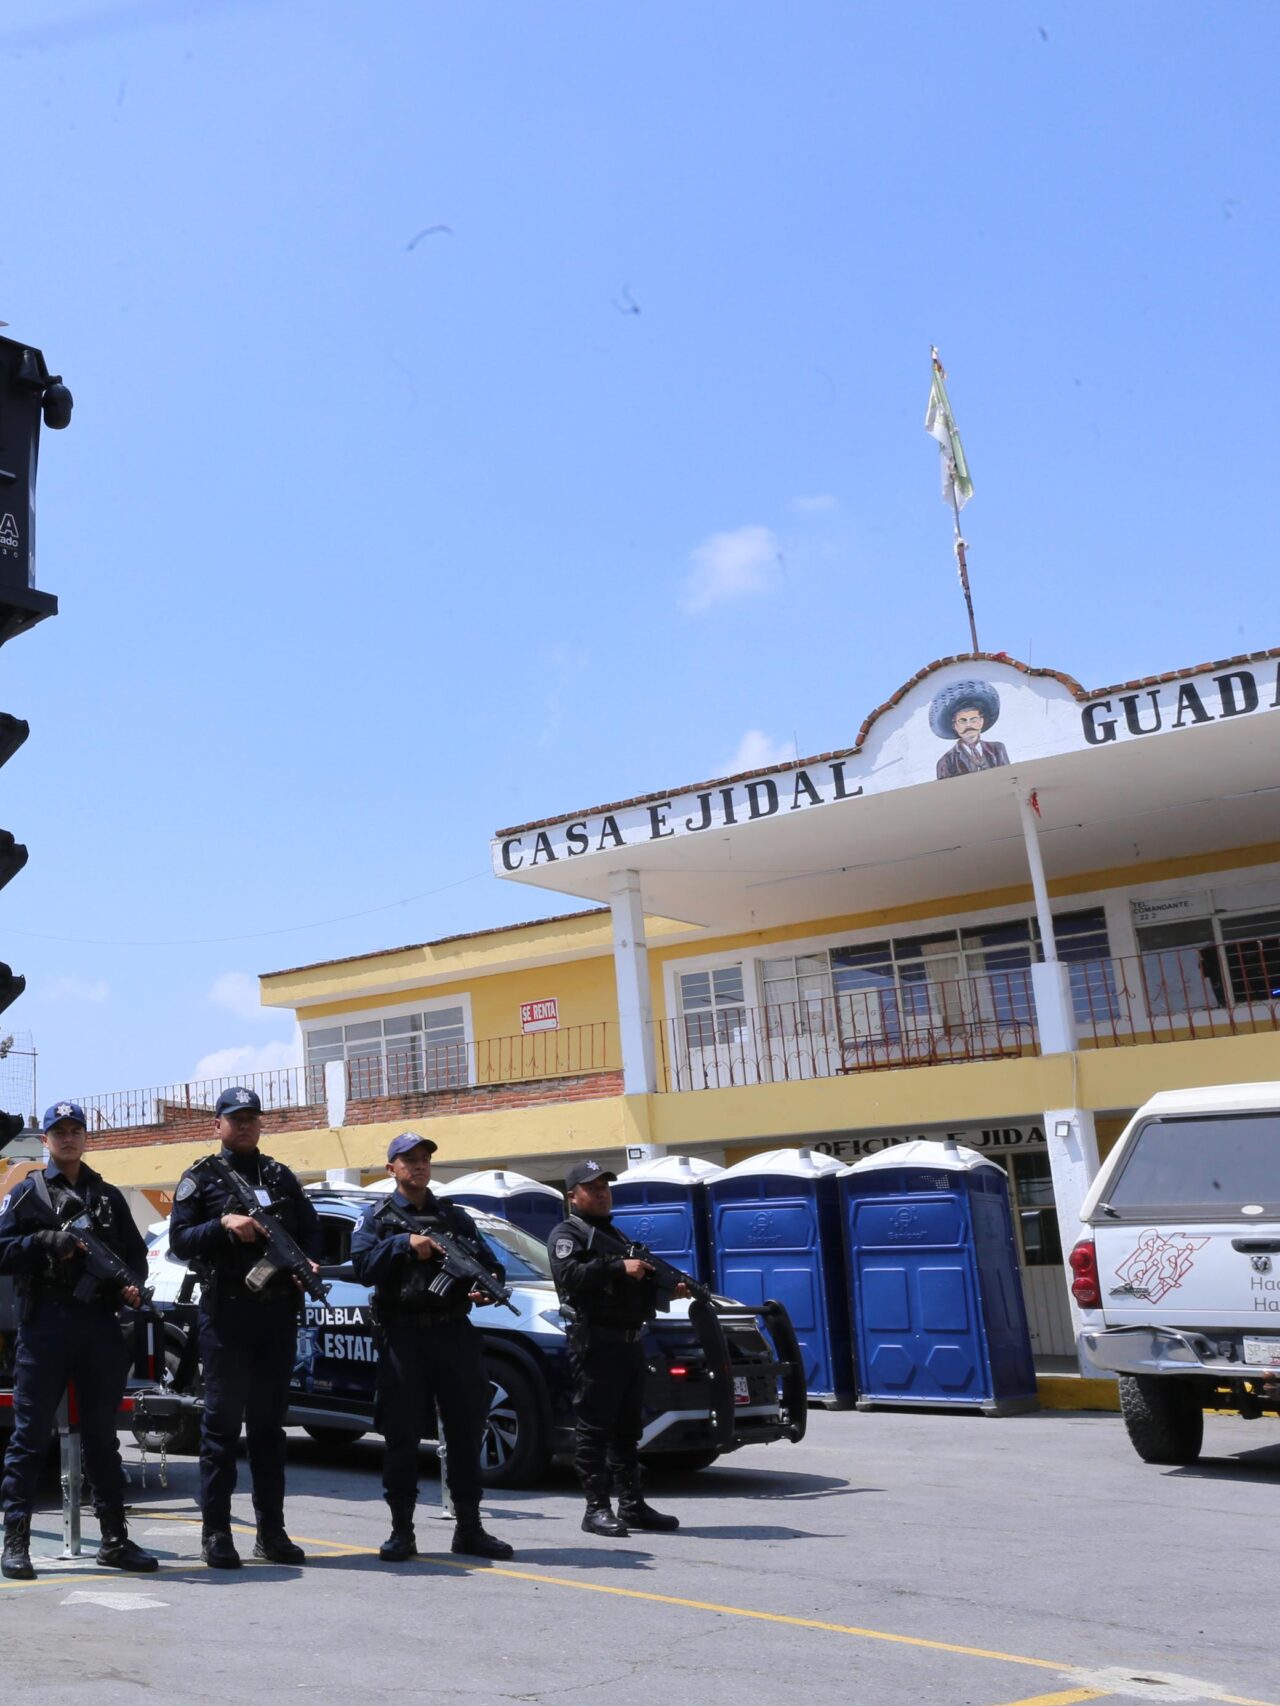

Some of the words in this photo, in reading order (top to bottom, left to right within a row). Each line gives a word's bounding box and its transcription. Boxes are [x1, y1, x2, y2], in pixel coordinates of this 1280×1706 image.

[501, 814, 628, 871] CASA
[646, 760, 864, 840] EJIDAL
[1081, 662, 1280, 745] GUAD
[523, 1005, 532, 1022] SE
[532, 1002, 556, 1020] RENTA
[305, 1307, 365, 1326] PUEBLA
